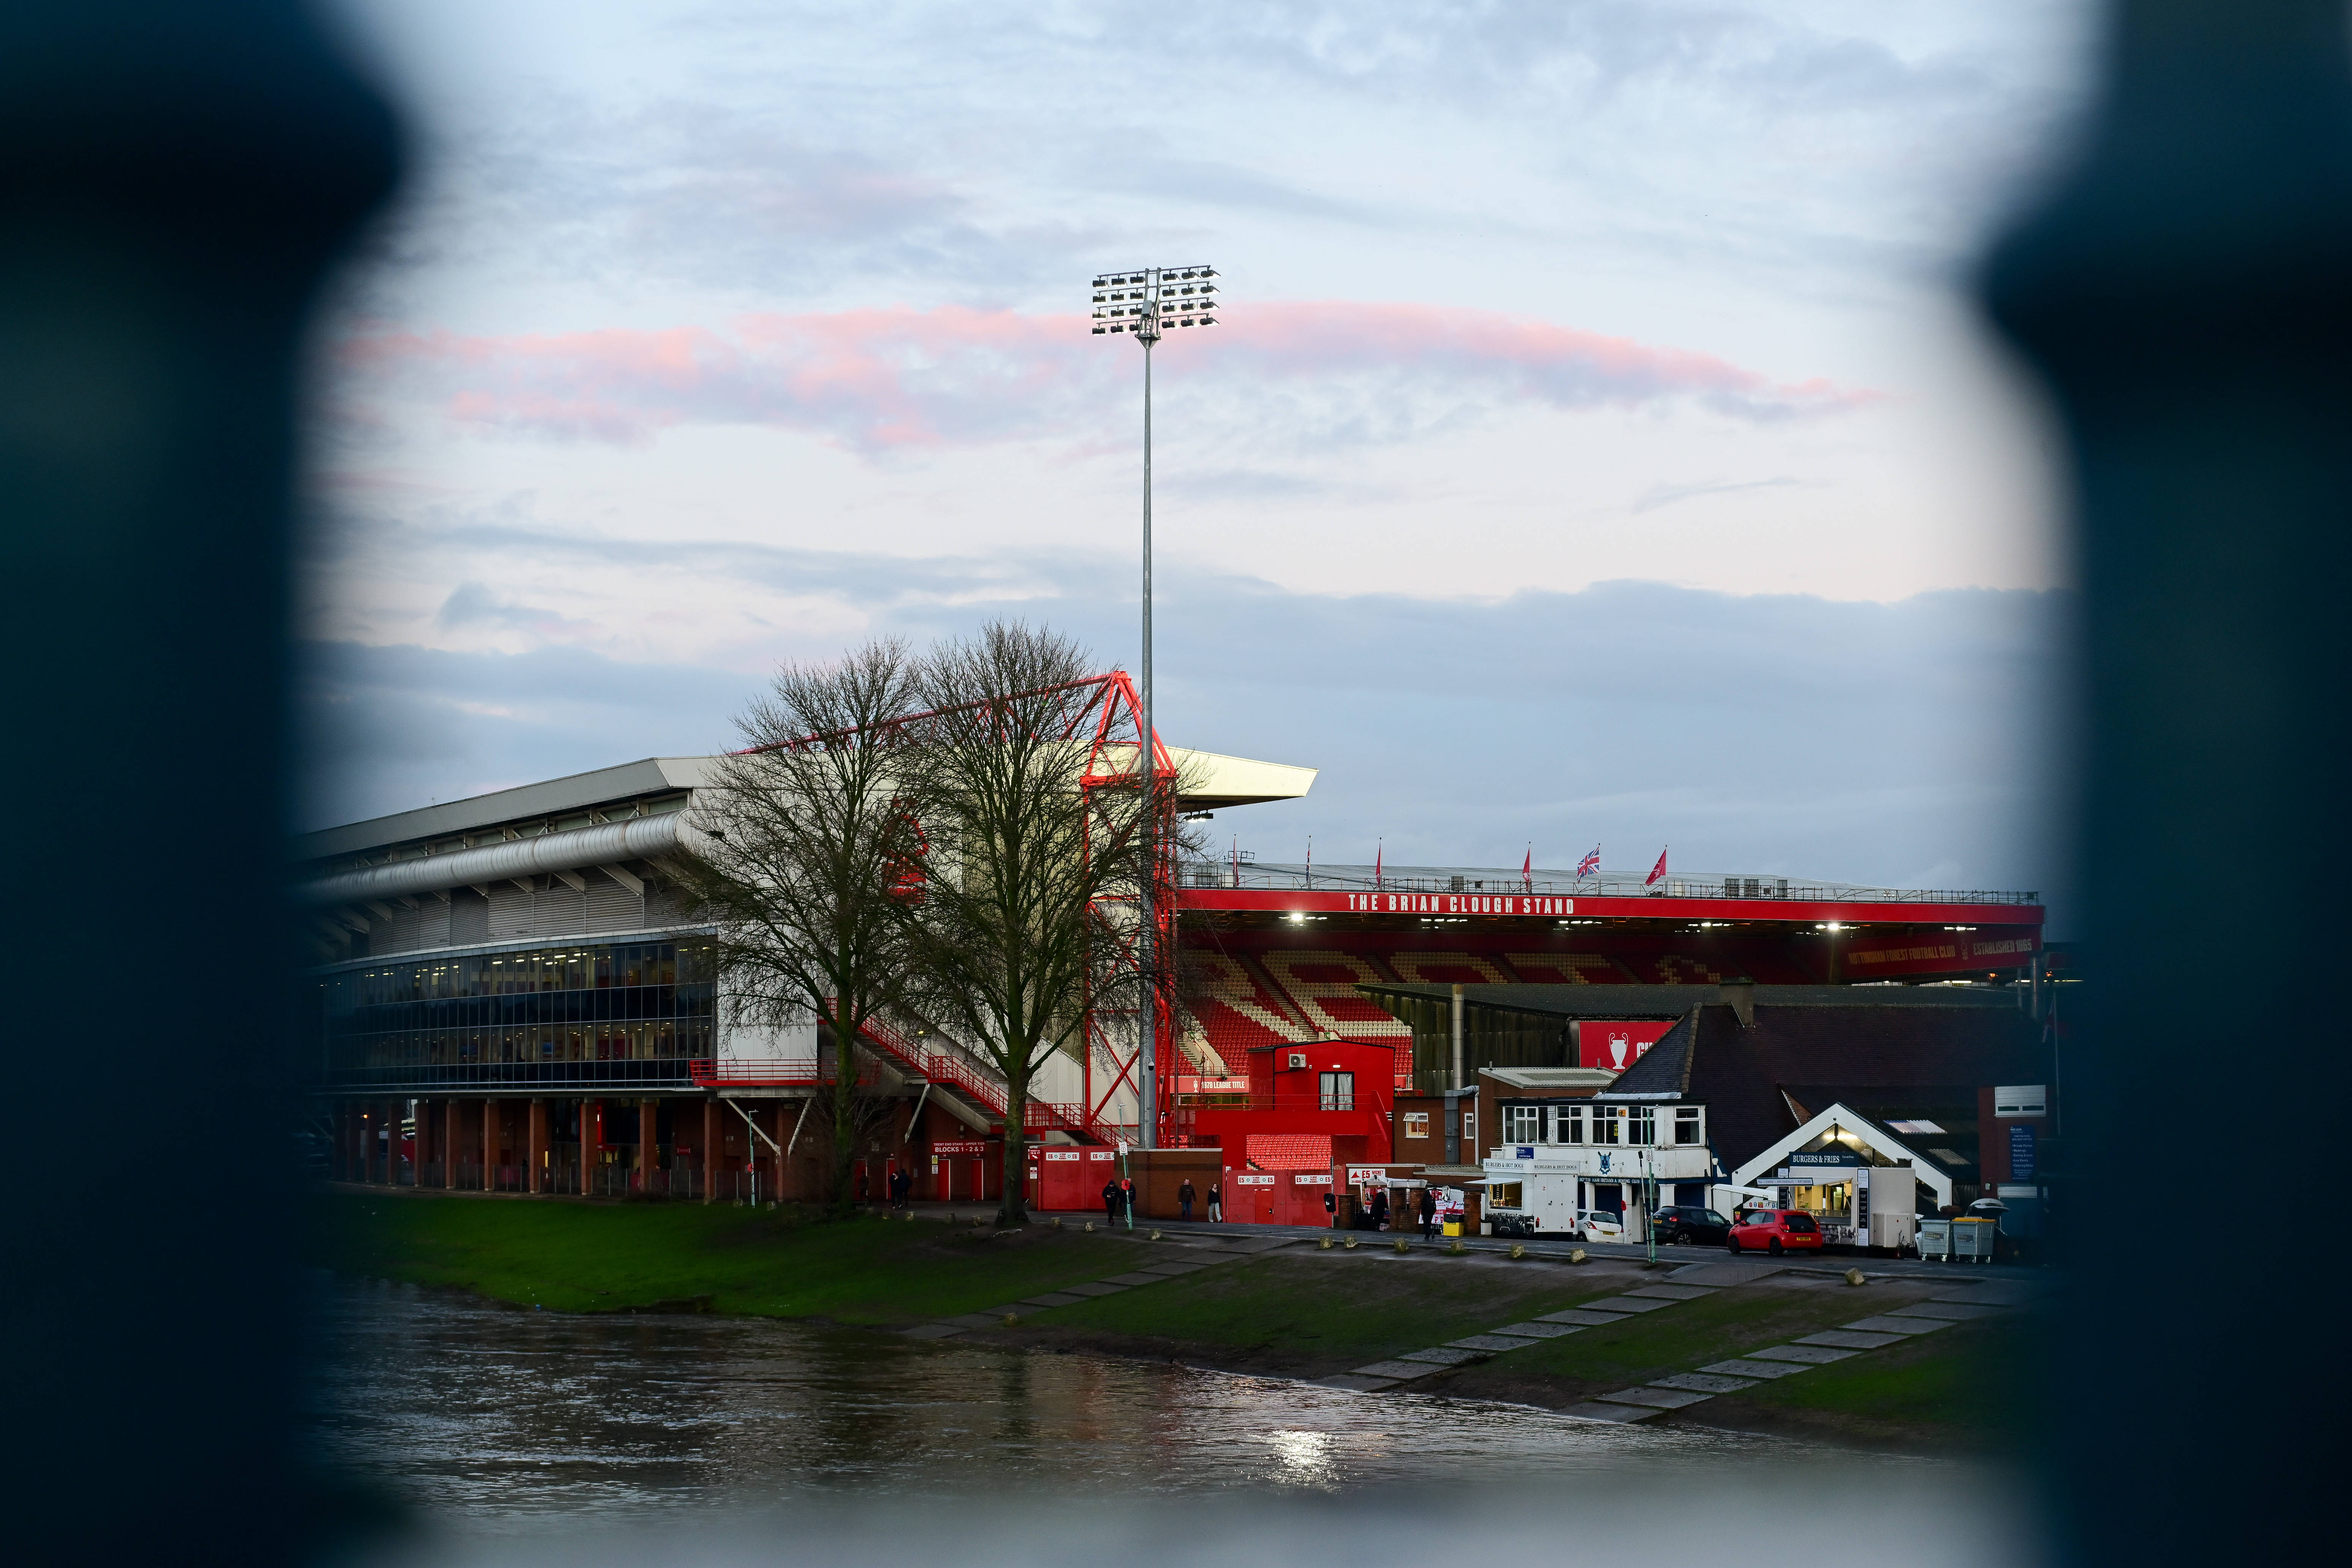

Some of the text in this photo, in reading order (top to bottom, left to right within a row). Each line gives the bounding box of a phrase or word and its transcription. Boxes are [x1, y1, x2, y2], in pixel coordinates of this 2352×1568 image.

[1349, 894, 1574, 914] THE BRIAN CLOUGH STAND
[1848, 945, 1955, 964] NOTTINGHAM FOREST FOOTBALL CLUB
[1973, 938, 2032, 955] ESTABLISHED 1865
